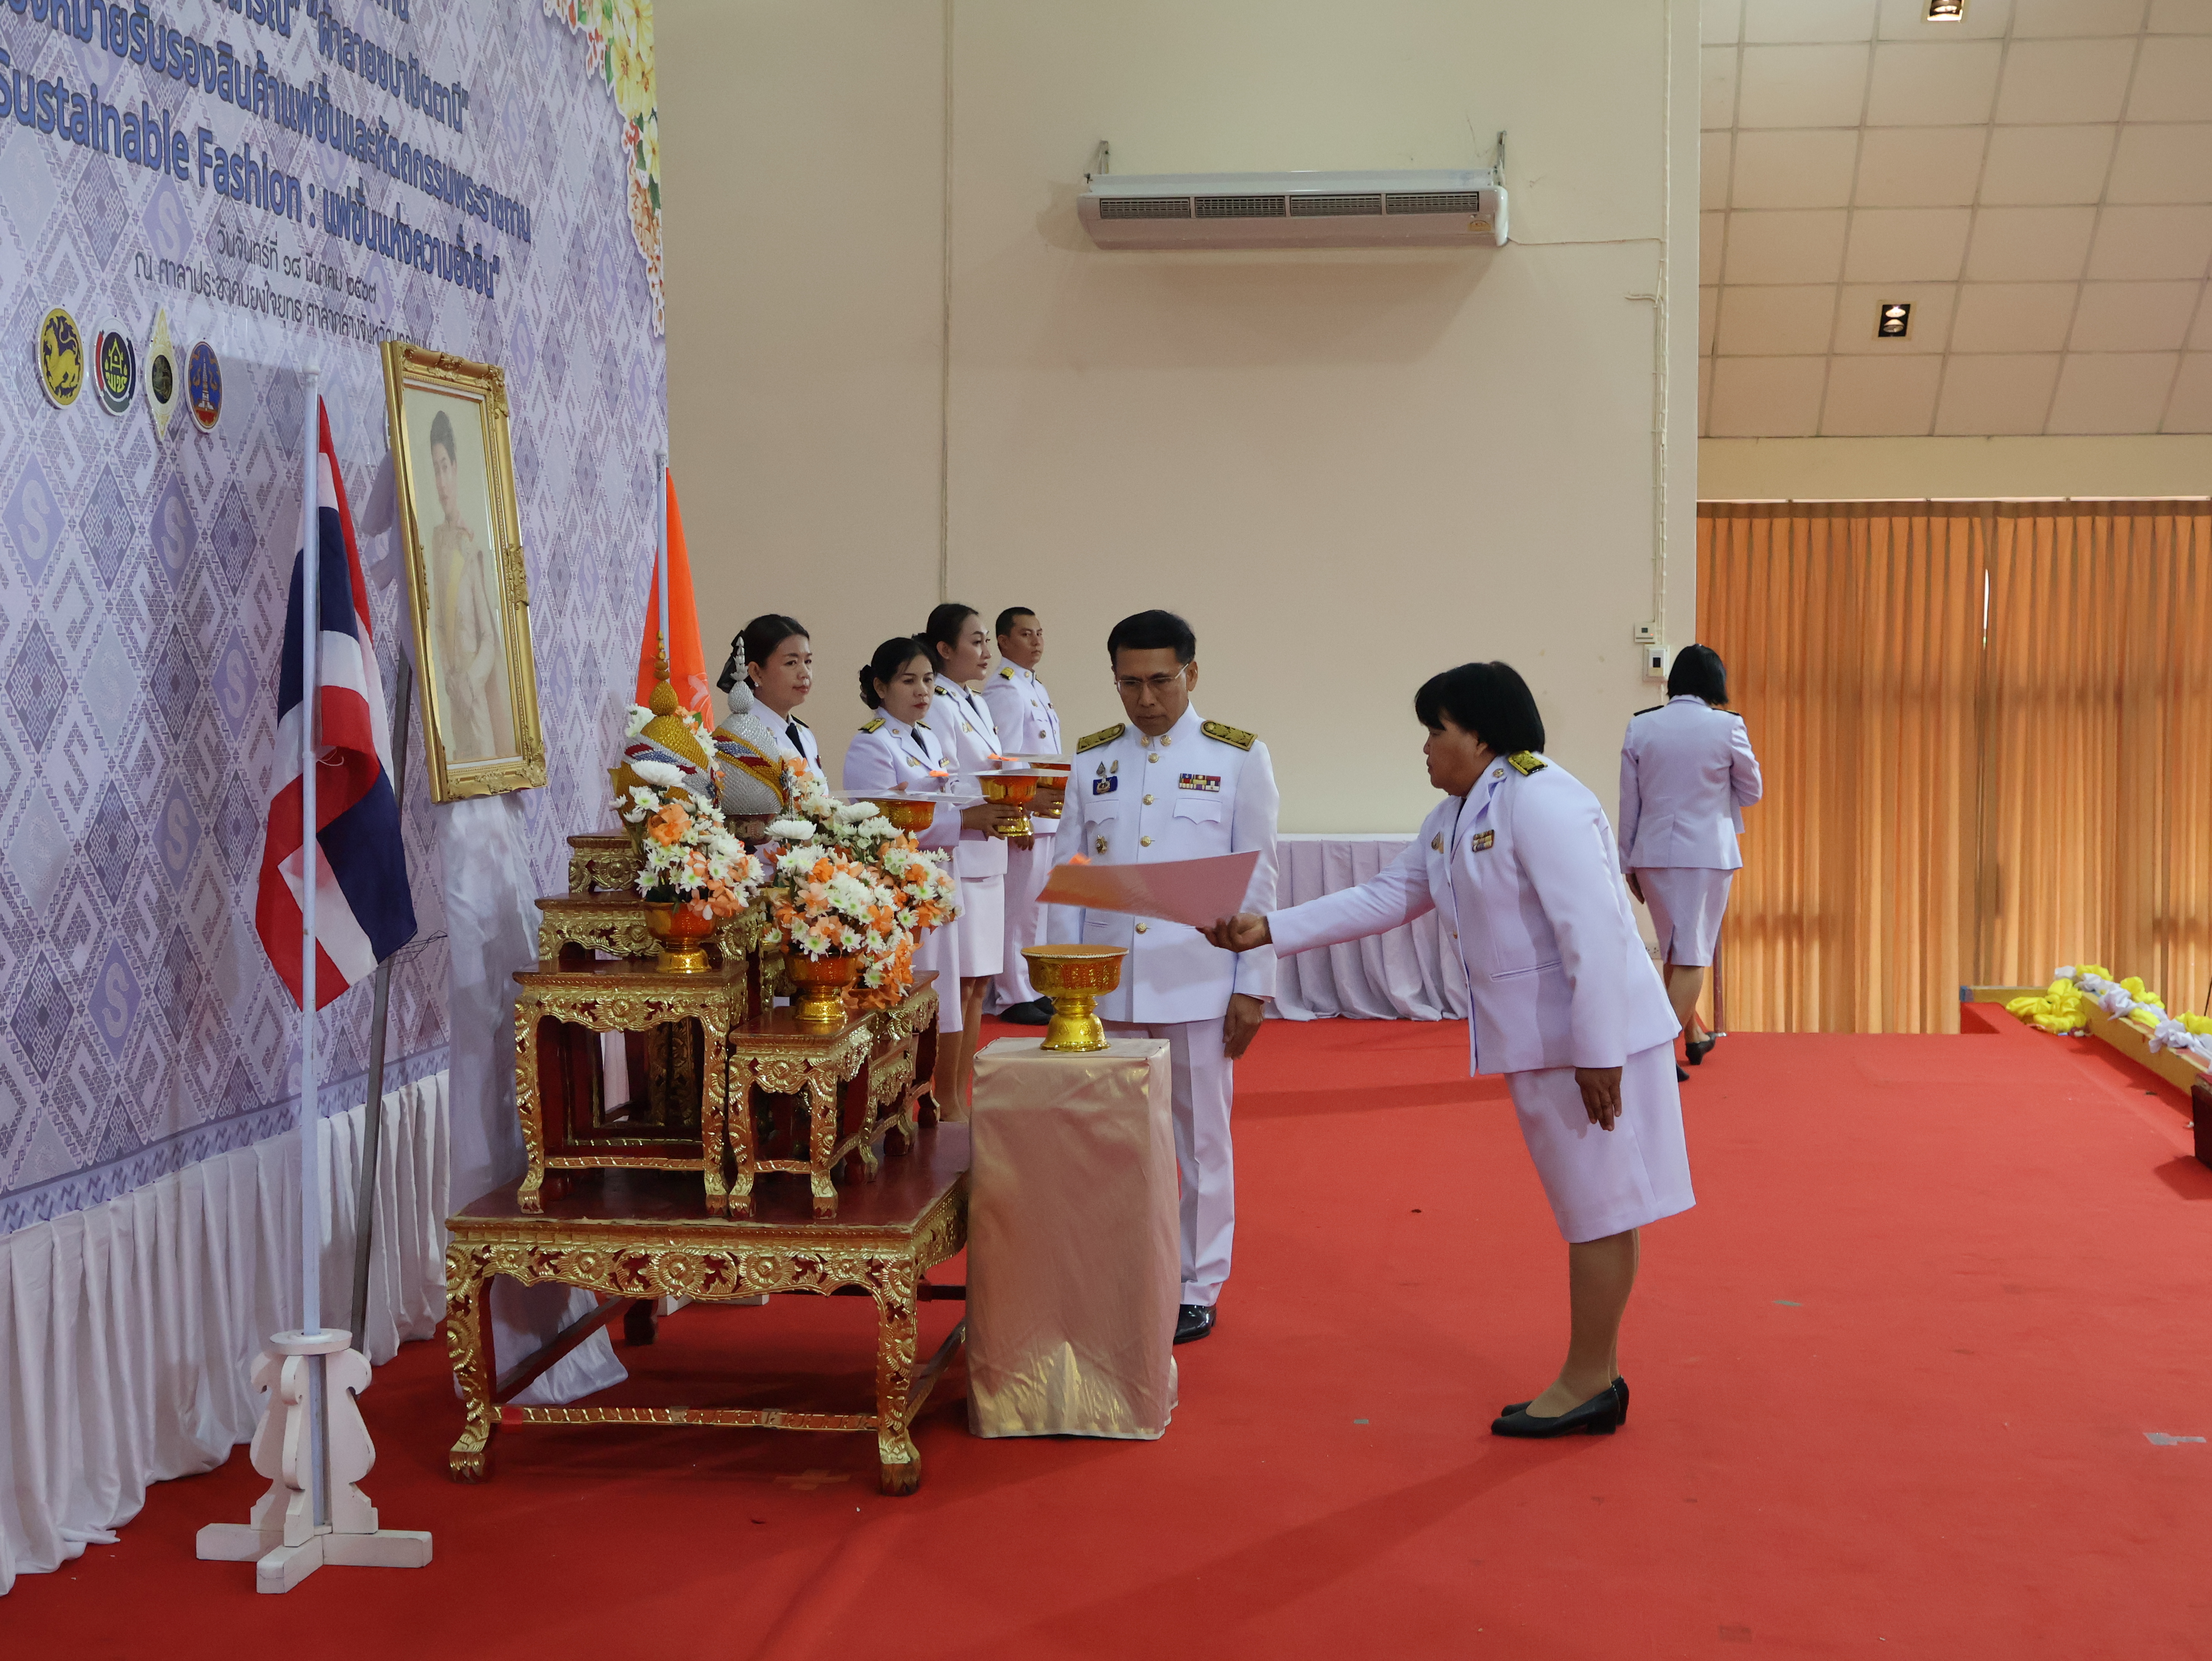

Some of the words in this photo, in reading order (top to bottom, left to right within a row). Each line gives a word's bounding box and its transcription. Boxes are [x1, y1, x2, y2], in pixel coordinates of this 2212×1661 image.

[198, 126, 302, 223] Fashion
[135, 252, 153, 280] ณ
[159, 258, 302, 328] ศาลาประชาคมยงใจยุทธ
[218, 221, 278, 272] วันจันทร์ที่
[283, 255, 301, 279] ๑๘
[306, 251, 343, 292] มีนาคม
[346, 271, 377, 304] ๒๕๖๗
